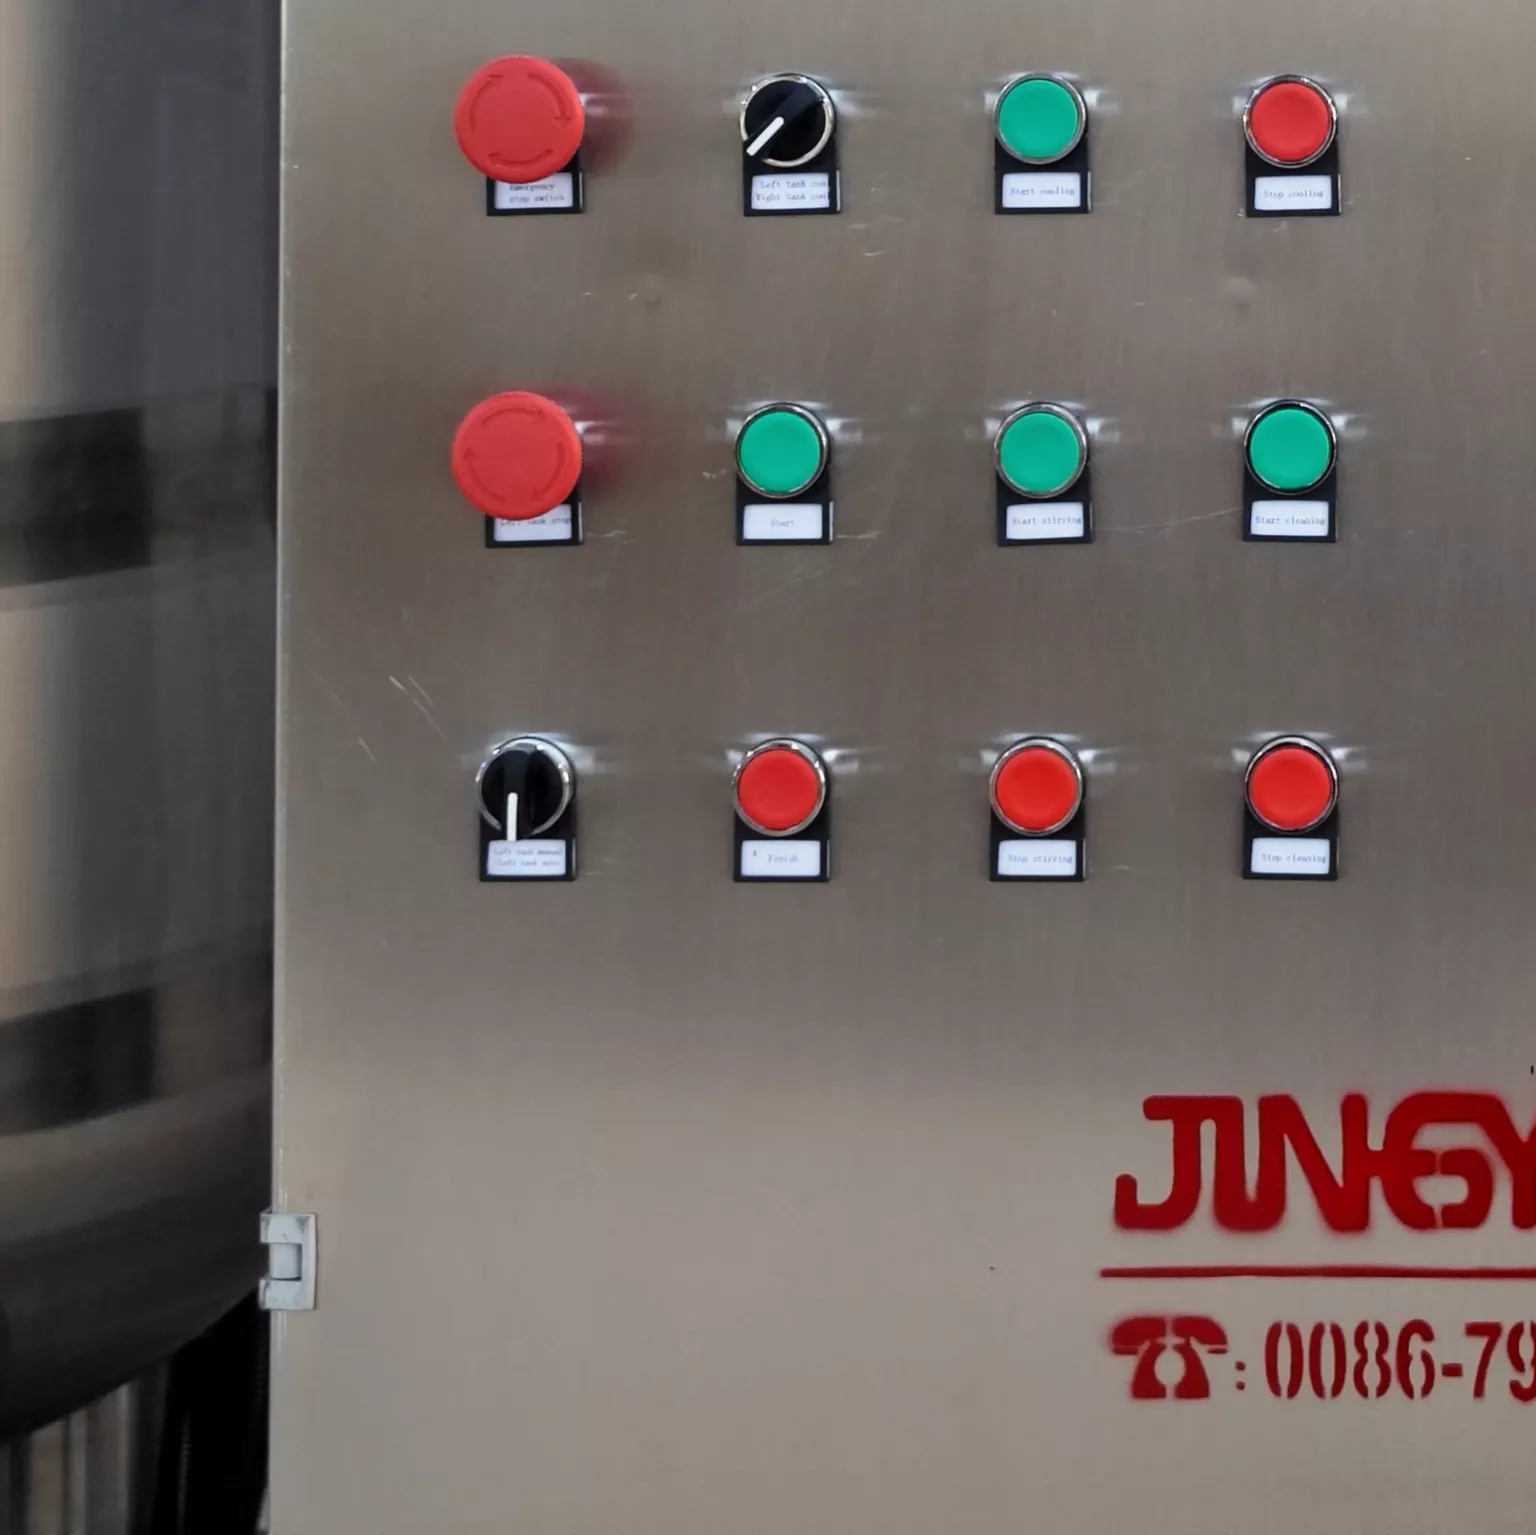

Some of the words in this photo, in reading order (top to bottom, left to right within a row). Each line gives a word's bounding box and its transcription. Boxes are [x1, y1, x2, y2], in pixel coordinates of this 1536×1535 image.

[1009, 187, 1035, 195] Start
[1264, 189, 1285, 199] Stop
[769, 518, 795, 527] Start
